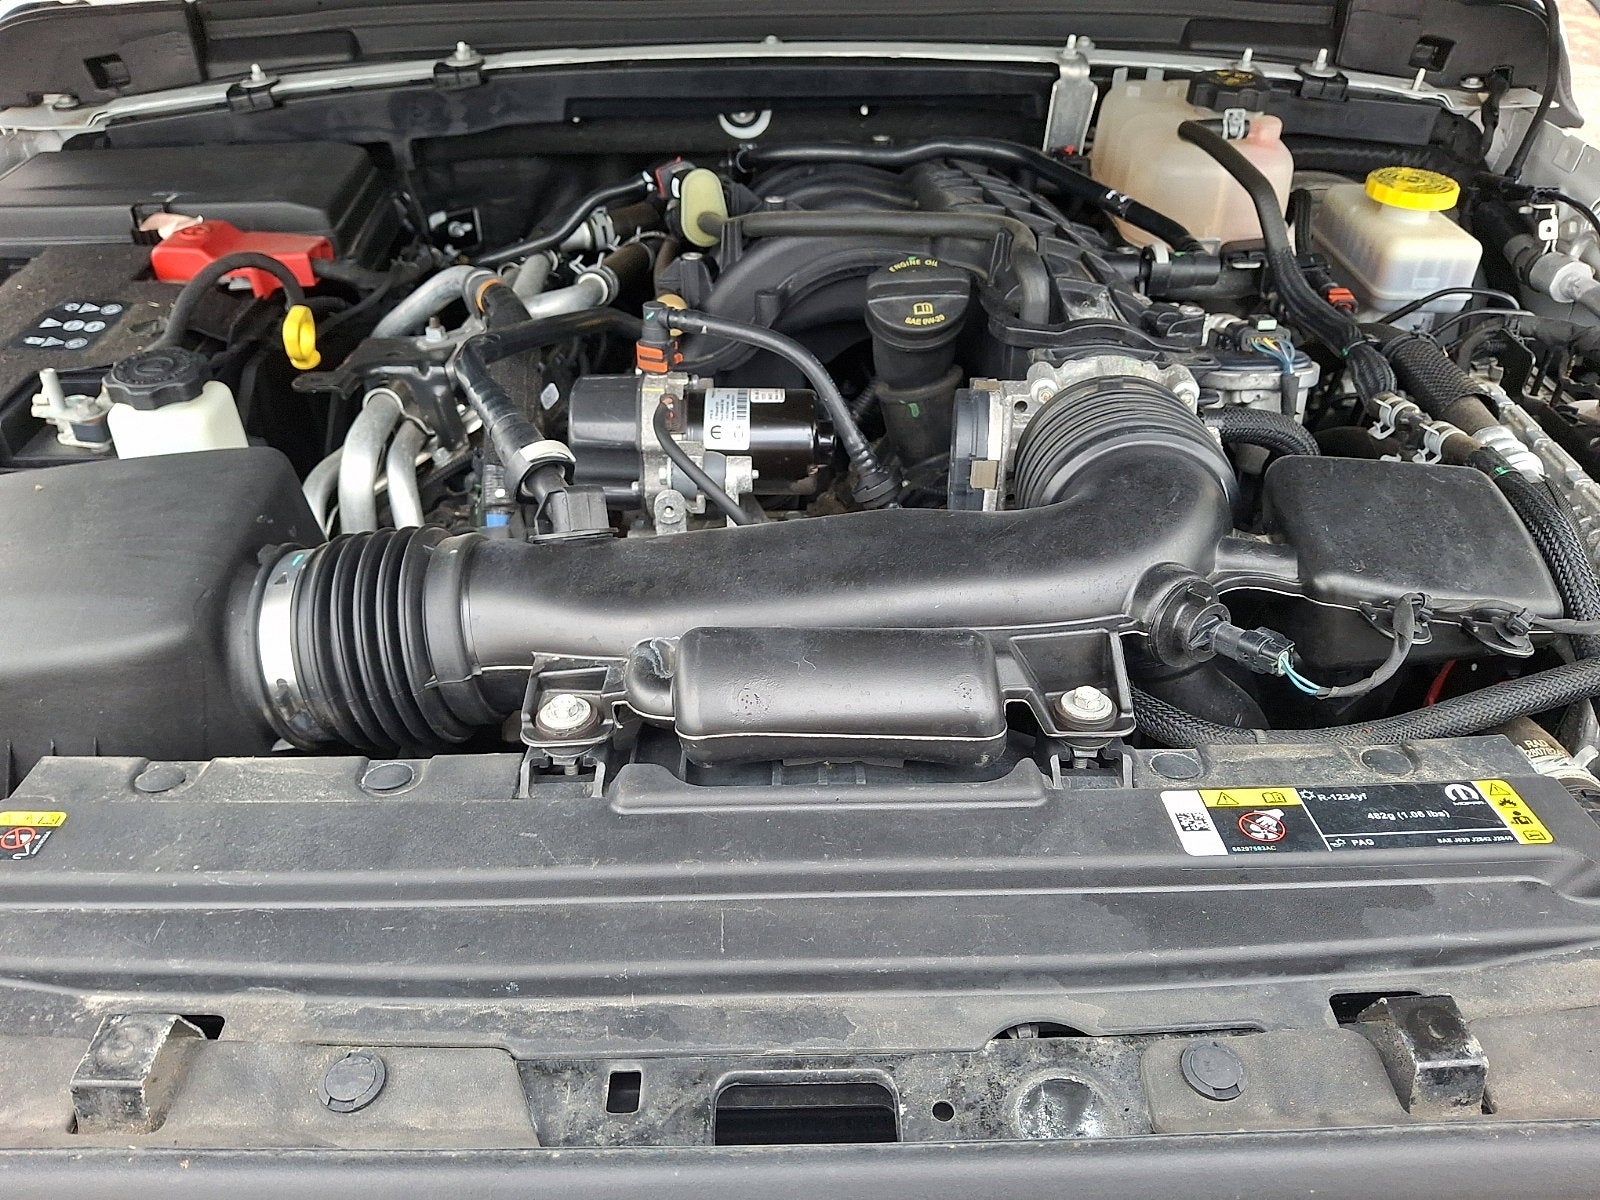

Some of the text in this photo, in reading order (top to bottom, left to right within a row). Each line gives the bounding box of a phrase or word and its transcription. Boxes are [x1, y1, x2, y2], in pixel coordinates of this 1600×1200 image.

[888, 259, 938, 272] ENGINE OIL
[905, 317, 922, 325] SAE
[1523, 739, 1549, 749] RAD
[1317, 793, 1367, 801] R-1234yf
[1426, 809, 1450, 818] lbs)
[1350, 838, 1375, 847] PAG
